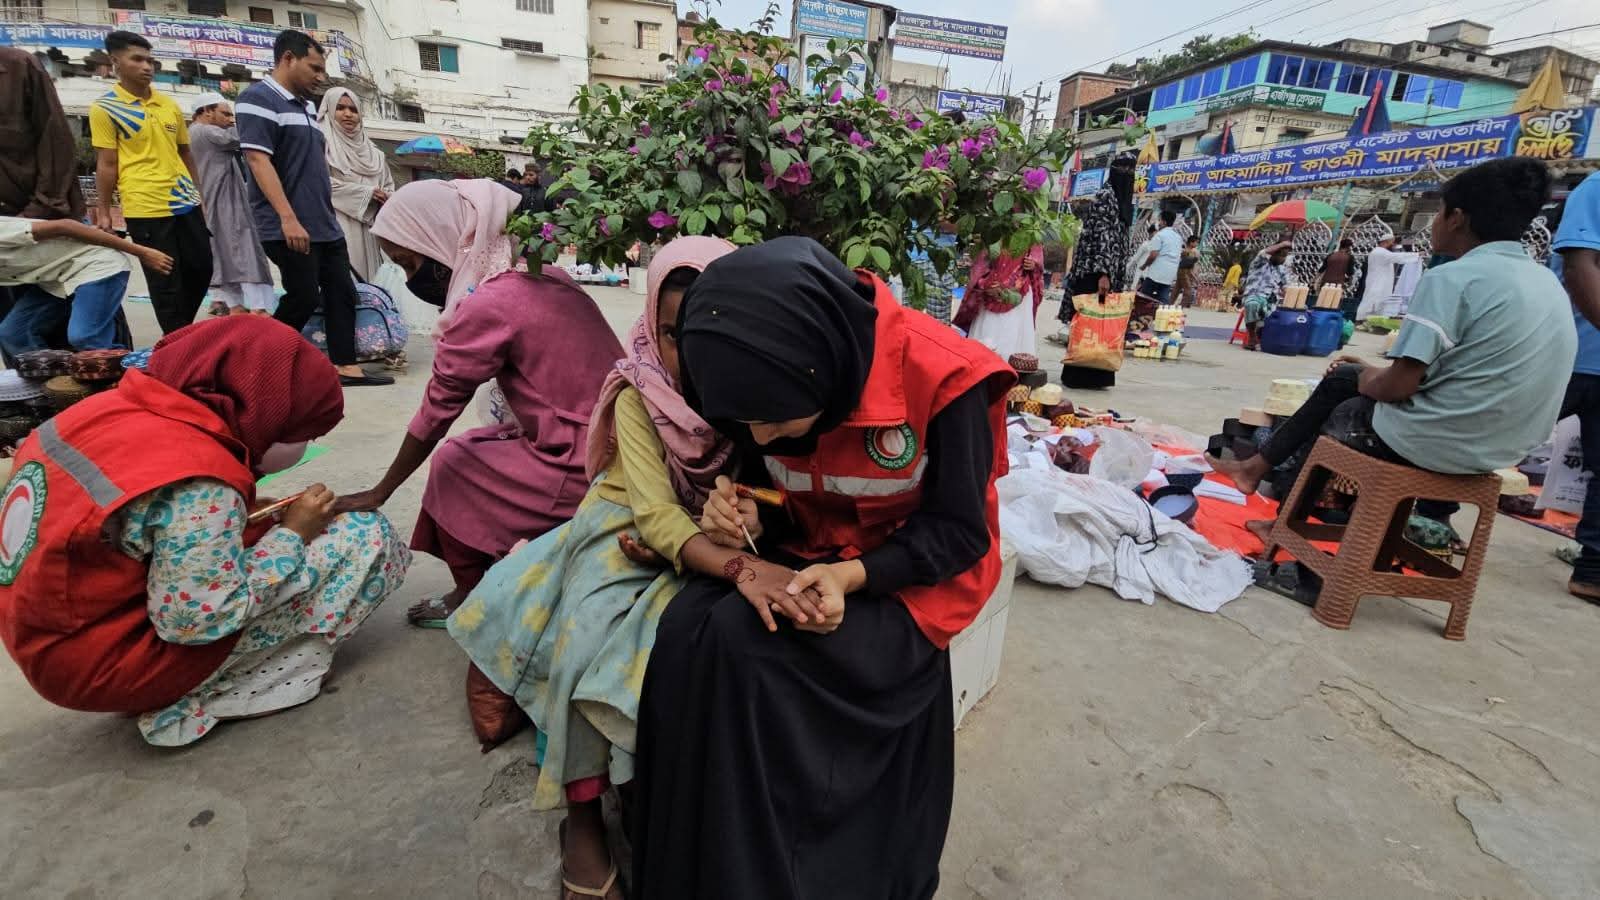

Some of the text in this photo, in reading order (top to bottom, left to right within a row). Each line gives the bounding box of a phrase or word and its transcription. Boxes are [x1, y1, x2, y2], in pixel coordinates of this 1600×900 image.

[1355, 131, 1412, 147] এস্টেট
[1416, 118, 1510, 141] আওতাধীন
[1156, 170, 1203, 186] জামিয়া
[1207, 161, 1295, 182] আহমাদিয়া
[1301, 148, 1368, 172] কাওমী
[1375, 136, 1506, 165] মাদরাসায়
